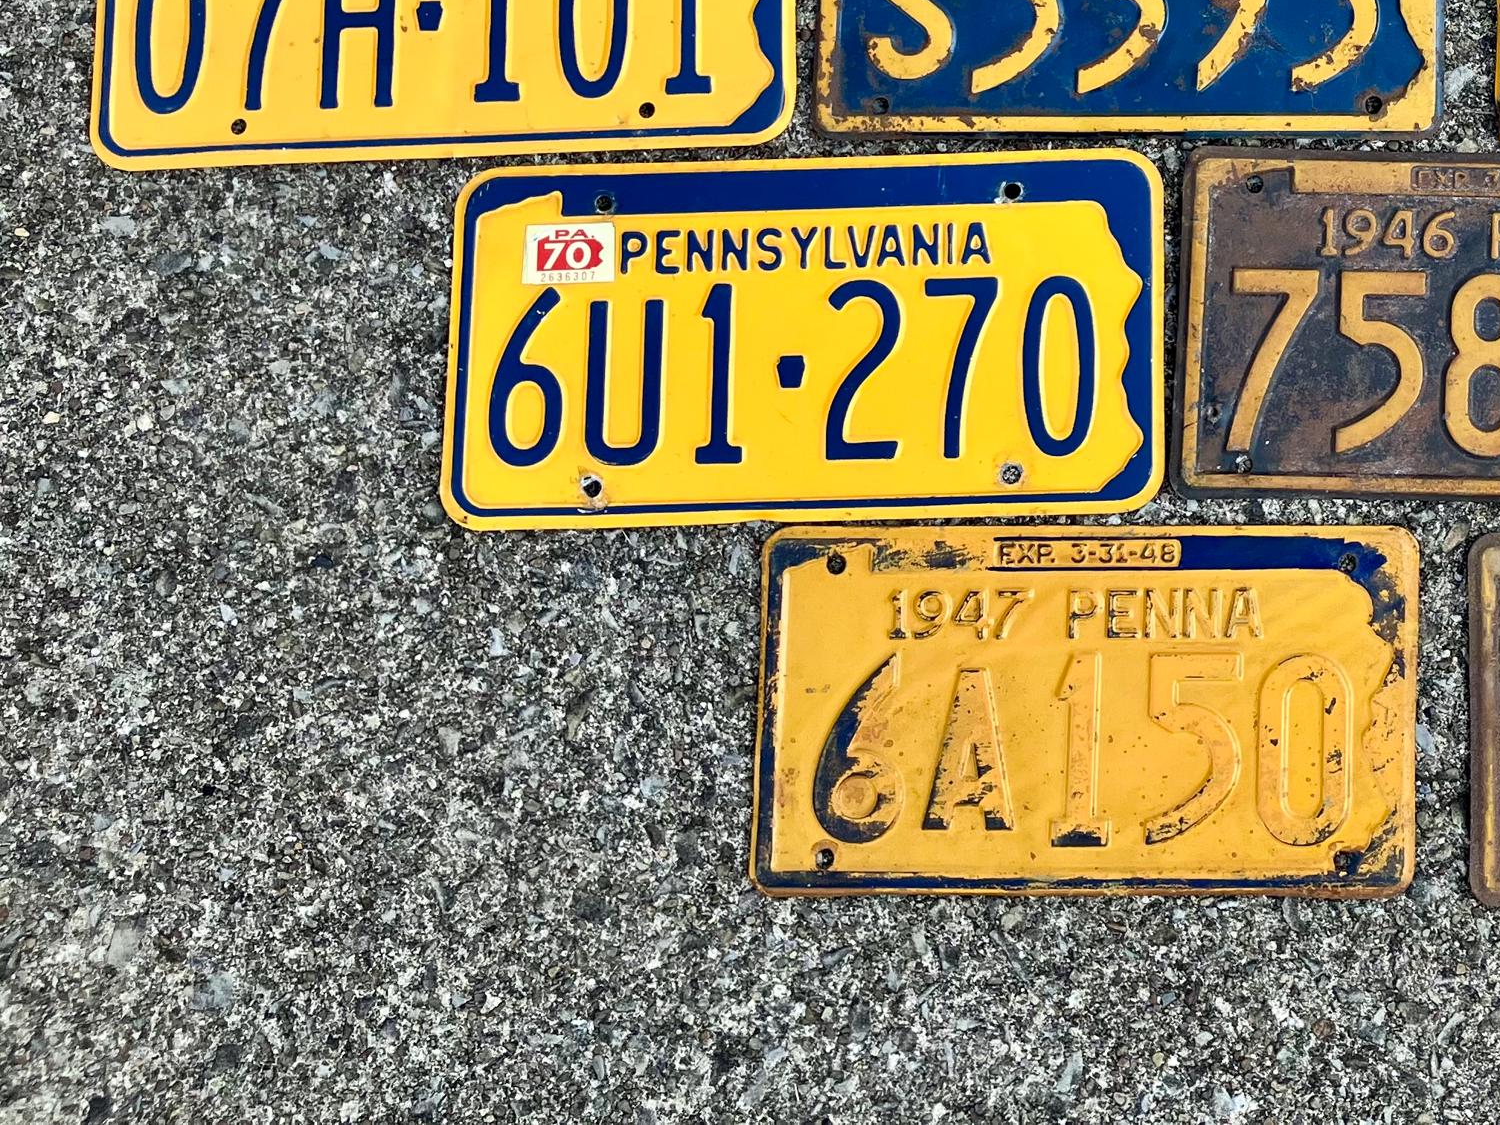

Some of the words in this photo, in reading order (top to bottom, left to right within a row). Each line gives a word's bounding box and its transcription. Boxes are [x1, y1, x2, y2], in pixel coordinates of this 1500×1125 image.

[544, 241, 592, 269] 70
[621, 222, 991, 273] PENNSYLVANIA
[1321, 207, 1455, 258] 1946
[541, 271, 596, 282] 2636307
[999, 543, 1055, 564] EXP.
[1071, 543, 1176, 564] 3-31-48
[890, 589, 1034, 640] 1947
[1068, 586, 1263, 639] PENNA
[813, 651, 1353, 846] 6A150
